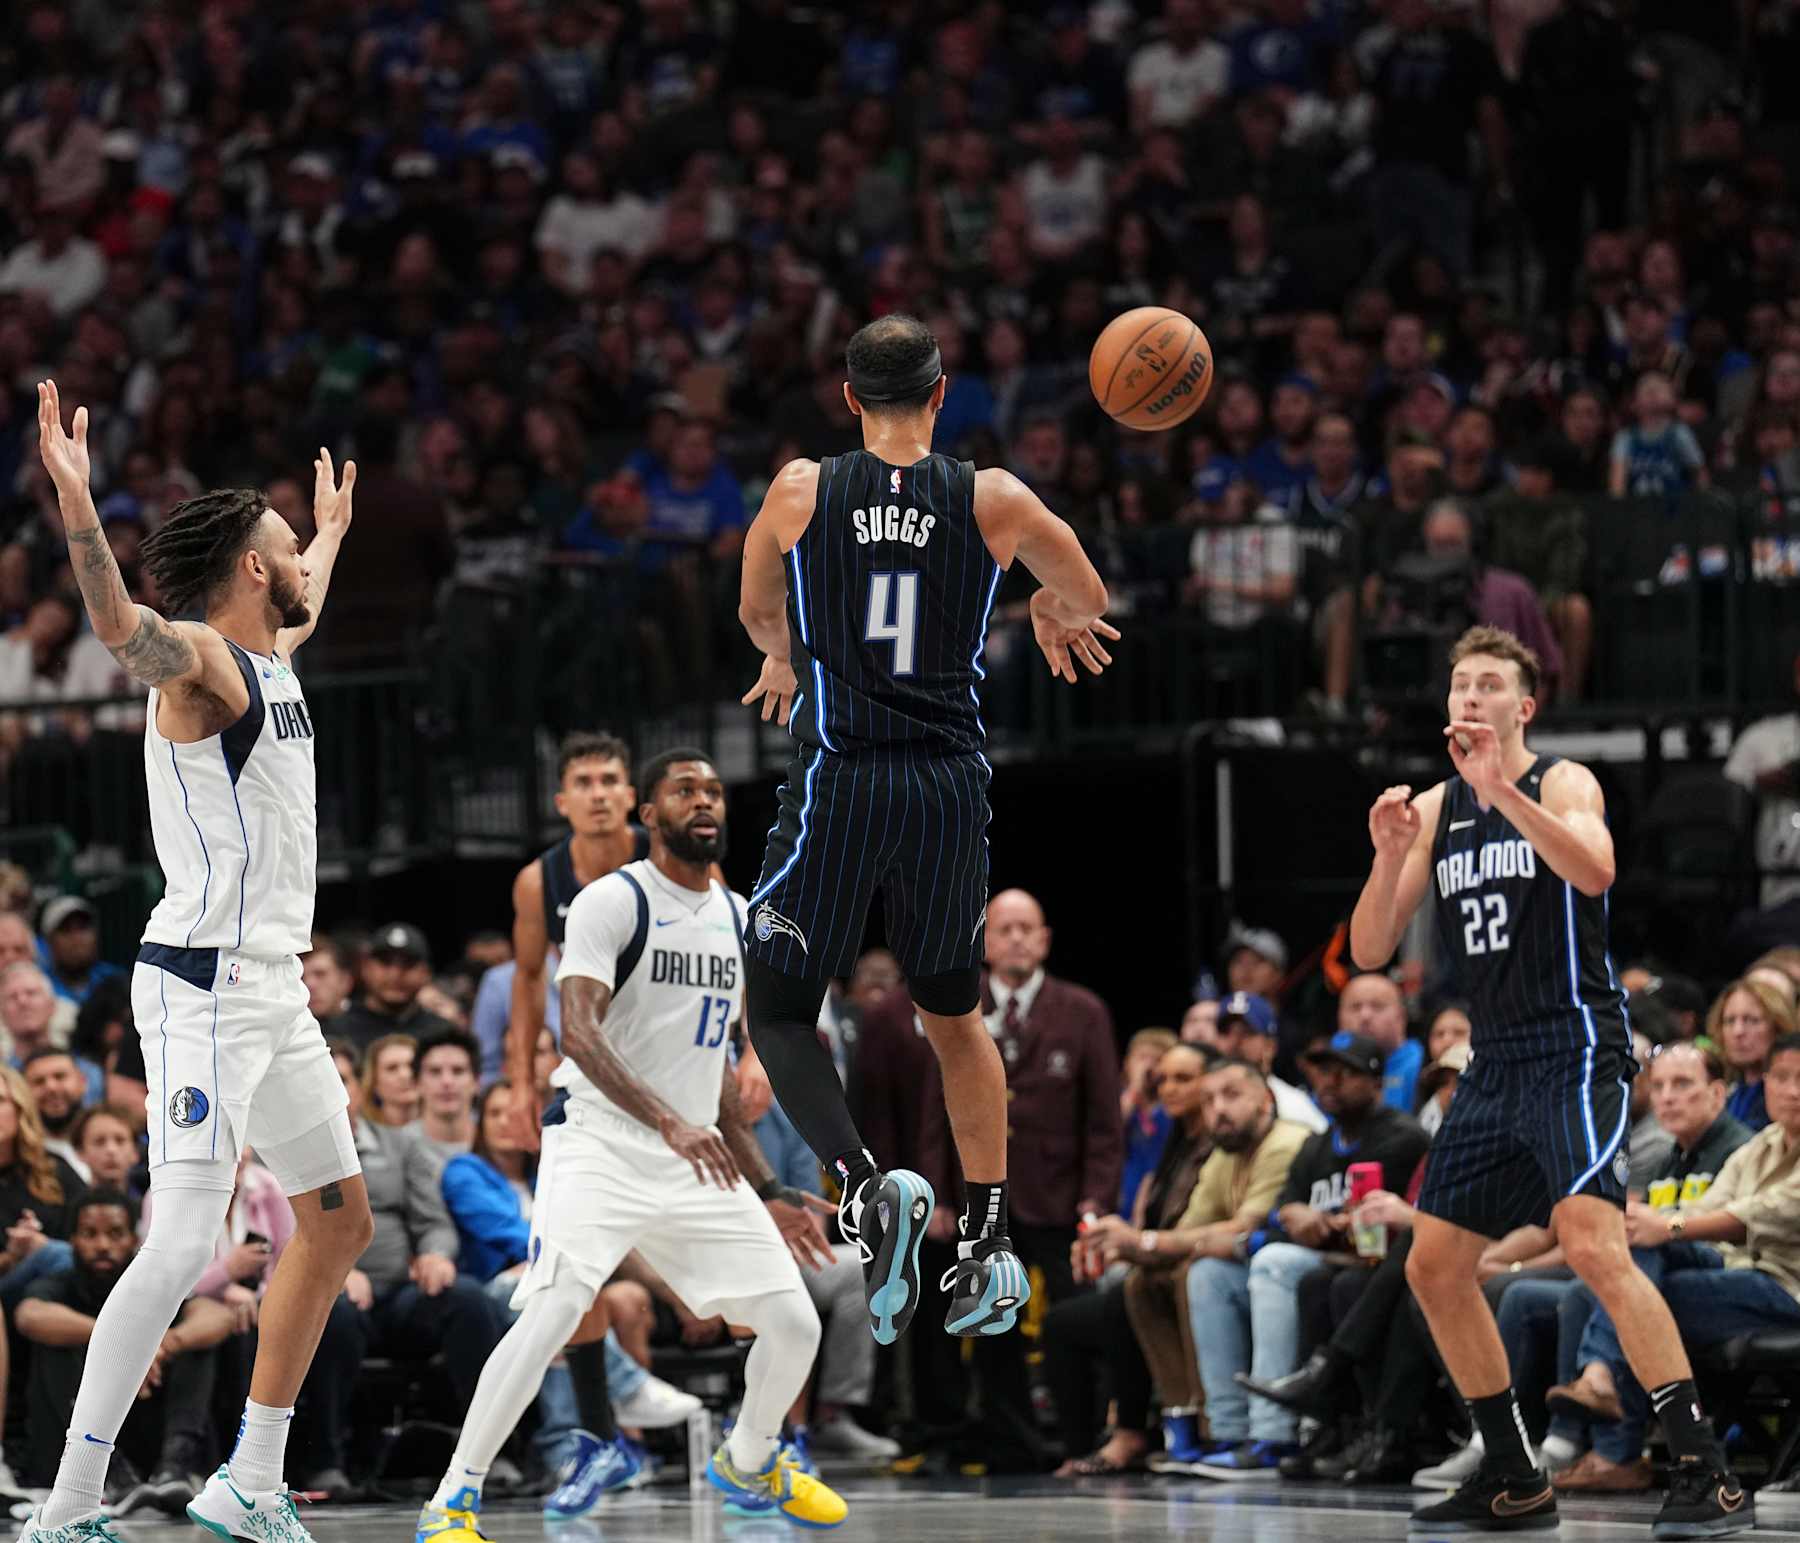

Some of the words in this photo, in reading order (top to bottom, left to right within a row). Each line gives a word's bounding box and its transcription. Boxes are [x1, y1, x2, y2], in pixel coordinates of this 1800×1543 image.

[1147, 352, 1207, 415] Wilson
[853, 505, 936, 548] SUGGS
[864, 572, 920, 677] 4
[1460, 893, 1510, 955] 22
[651, 949, 736, 990] DALLAS
[694, 995, 730, 1048] 13
